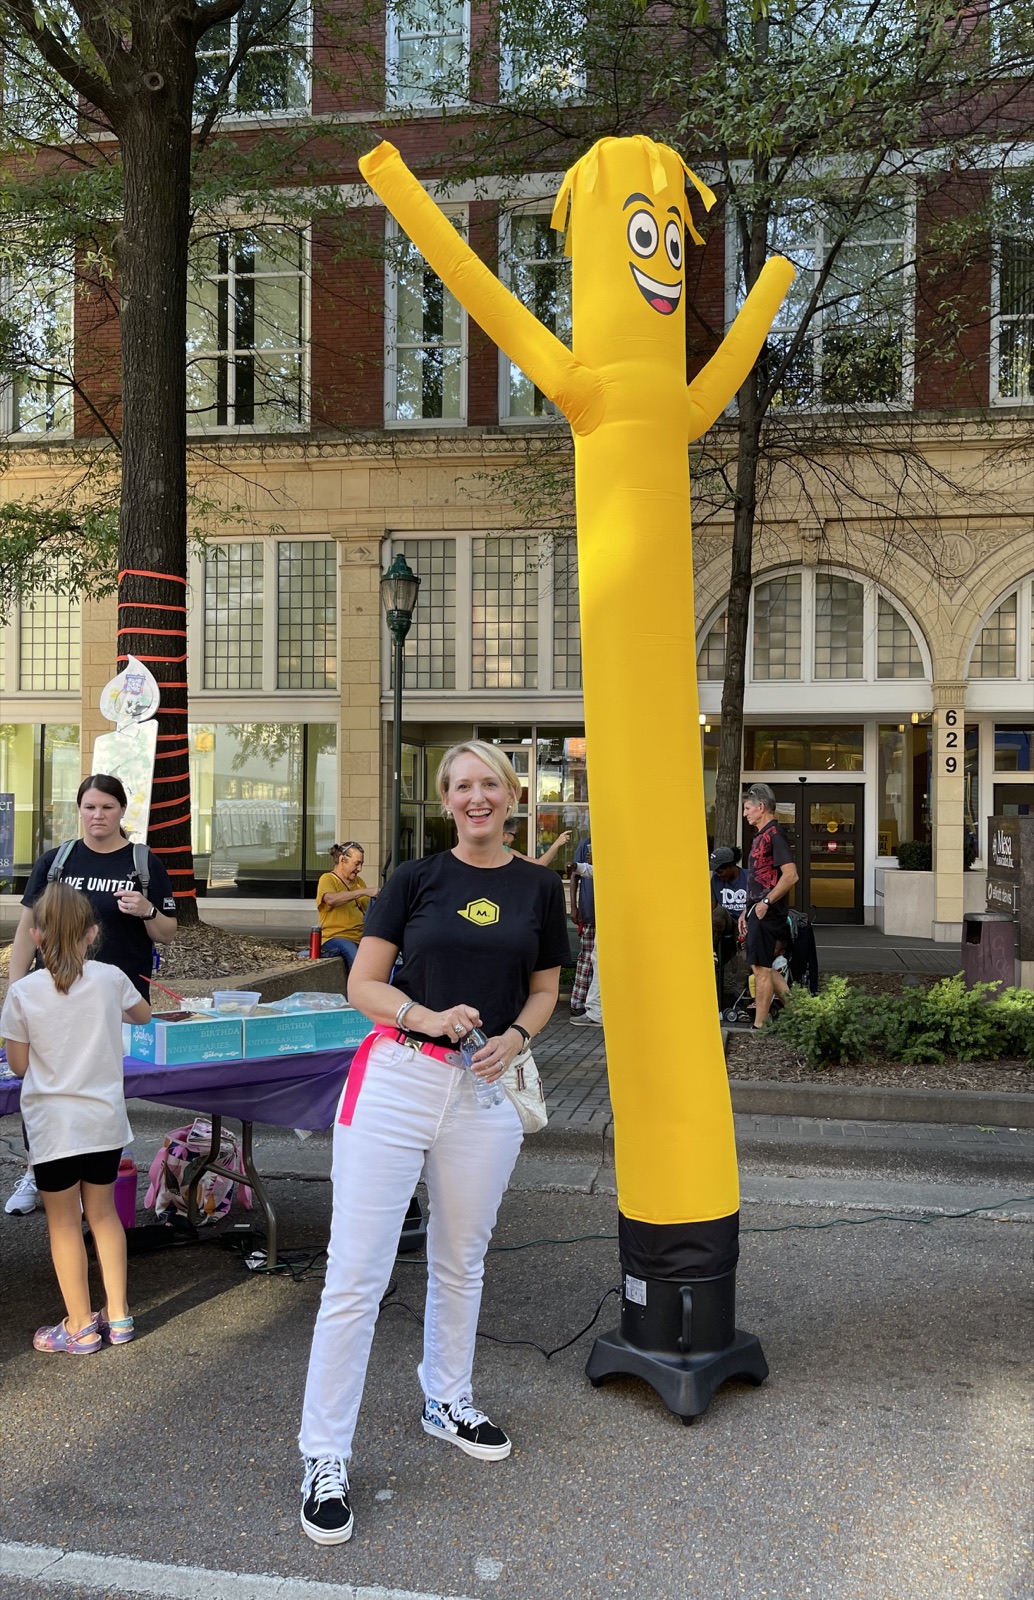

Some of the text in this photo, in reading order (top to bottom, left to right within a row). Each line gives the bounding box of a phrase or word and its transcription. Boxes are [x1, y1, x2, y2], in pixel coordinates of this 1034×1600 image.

[87, 877, 134, 892] UNITED
[276, 1021, 315, 1031] BIRTHDA
[200, 1027, 241, 1038] BIRTHDA
